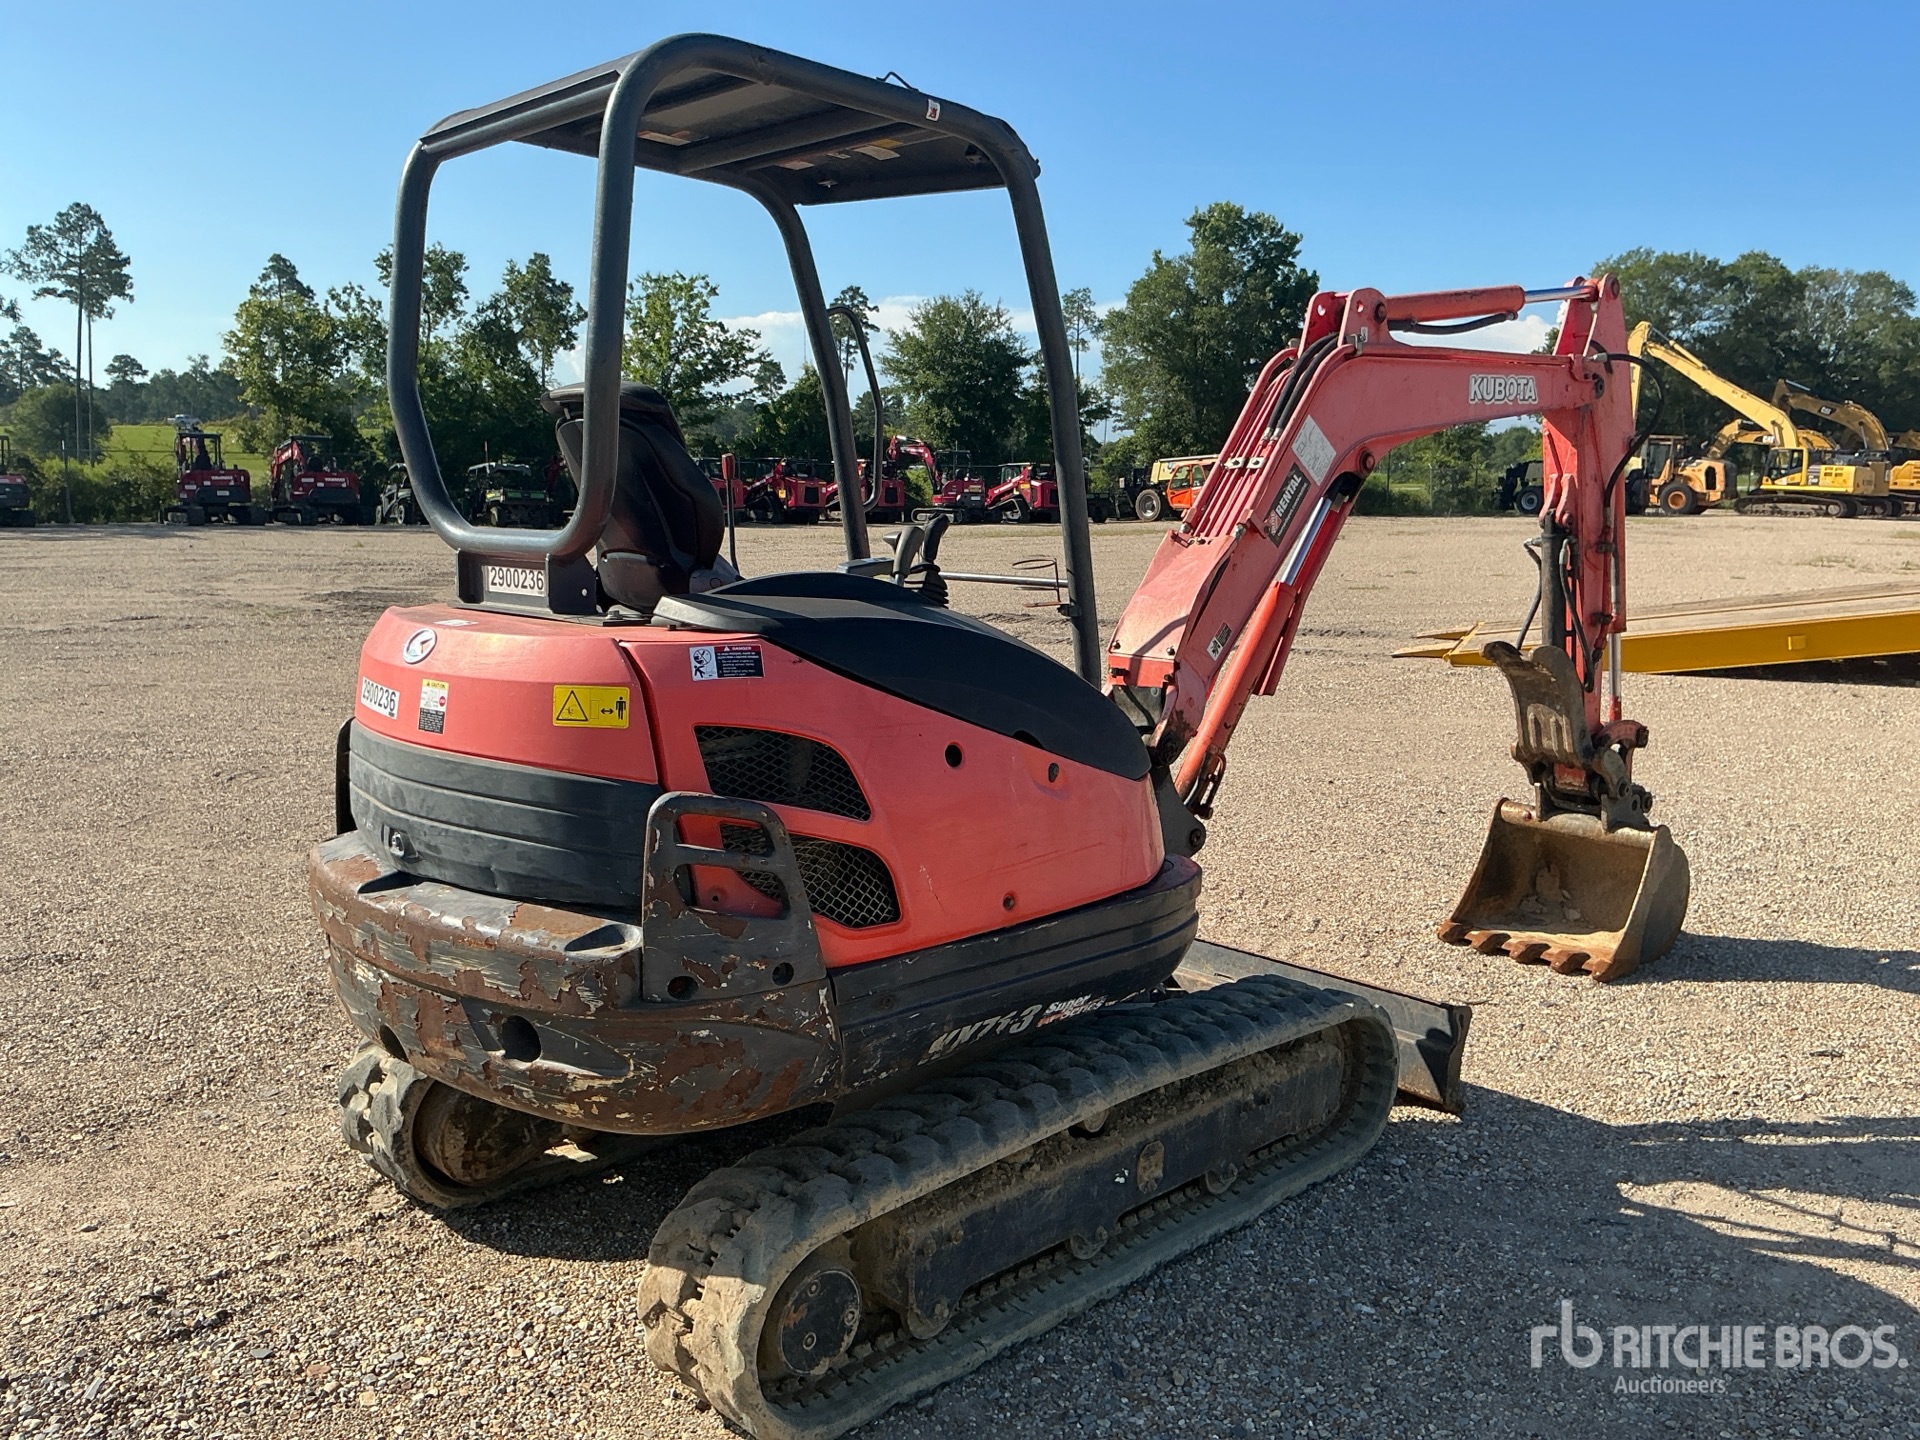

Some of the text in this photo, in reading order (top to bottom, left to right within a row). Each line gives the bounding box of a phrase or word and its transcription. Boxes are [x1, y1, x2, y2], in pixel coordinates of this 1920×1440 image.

[1469, 375, 1537, 403] KUBOTA
[1275, 474, 1302, 517] RENTAL
[490, 566, 544, 591] 2900236
[362, 679, 397, 712] 2900236
